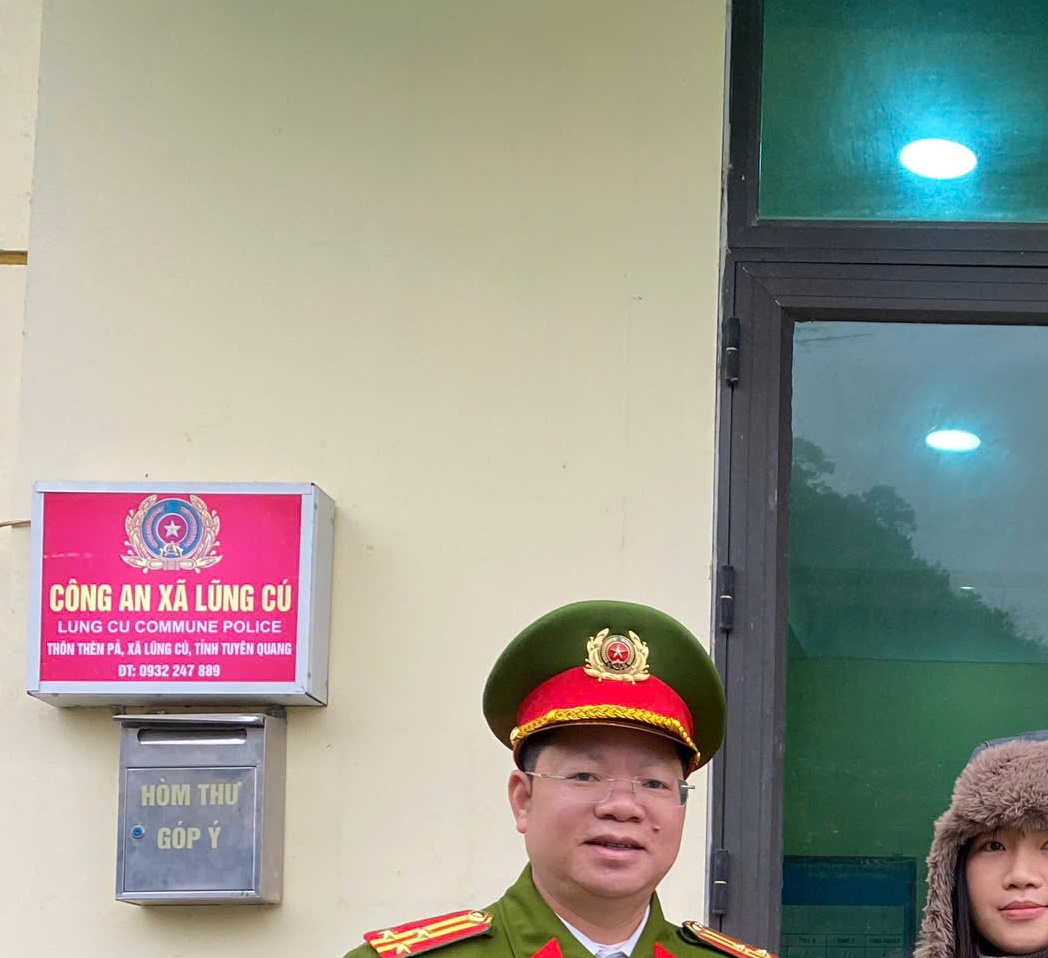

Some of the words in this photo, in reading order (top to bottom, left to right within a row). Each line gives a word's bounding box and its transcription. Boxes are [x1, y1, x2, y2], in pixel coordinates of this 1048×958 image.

[50, 578, 112, 612] CÔNG
[118, 584, 151, 612] AN
[158, 579, 188, 612] XÃ
[195, 579, 255, 612] LŨNG
[261, 579, 292, 612] CÚ
[58, 620, 103, 634] LUNG
[107, 620, 130, 634] CU
[135, 620, 218, 634] COMMUNE
[223, 620, 282, 634] POLICE
[47, 640, 75, 656] THÔN
[127, 640, 142, 656] XÃ
[144, 640, 171, 656] LŨNG
[195, 639, 219, 656] TỈNH
[221, 640, 254, 656] TUYÊN
[256, 642, 292, 657] QUANG
[118, 664, 136, 677] ĐT:
[139, 664, 169, 677] 0932
[172, 664, 195, 677] 247
[198, 664, 221, 677] 889
[141, 778, 191, 806] HÒM
[198, 781, 243, 806] THƯ
[157, 820, 201, 850] GÓP
[208, 820, 223, 850] Ý
